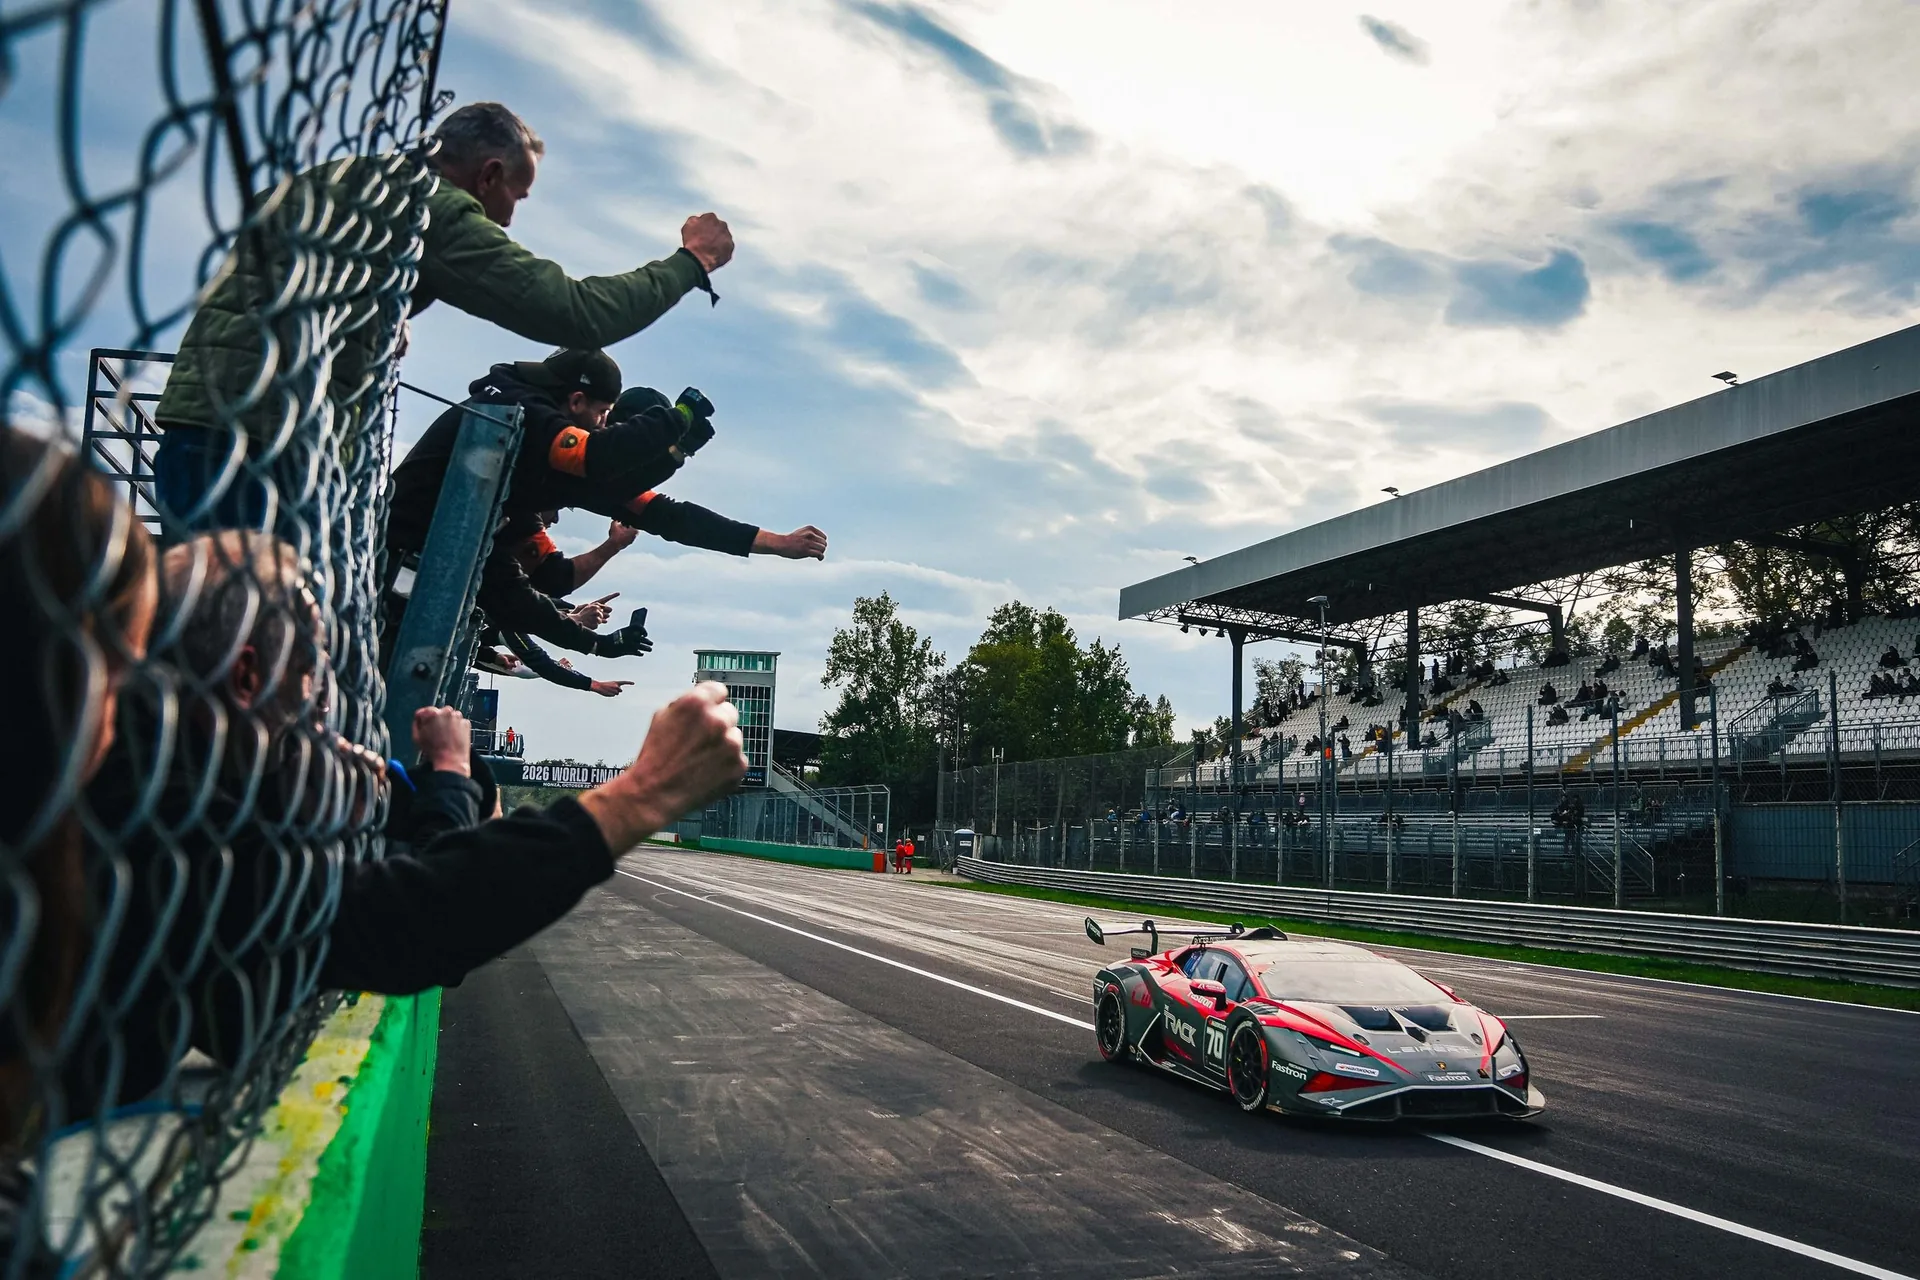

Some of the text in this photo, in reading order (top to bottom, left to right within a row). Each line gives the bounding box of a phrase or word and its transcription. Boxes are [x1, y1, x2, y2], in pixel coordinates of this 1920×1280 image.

[522, 765, 549, 781] 2026
[552, 766, 588, 782] WORLD
[1163, 1008, 1197, 1048] TRACK
[1206, 1026, 1224, 1060] 70
[1271, 1060, 1307, 1081] Fastron
[1427, 1073, 1471, 1083] Fastron
